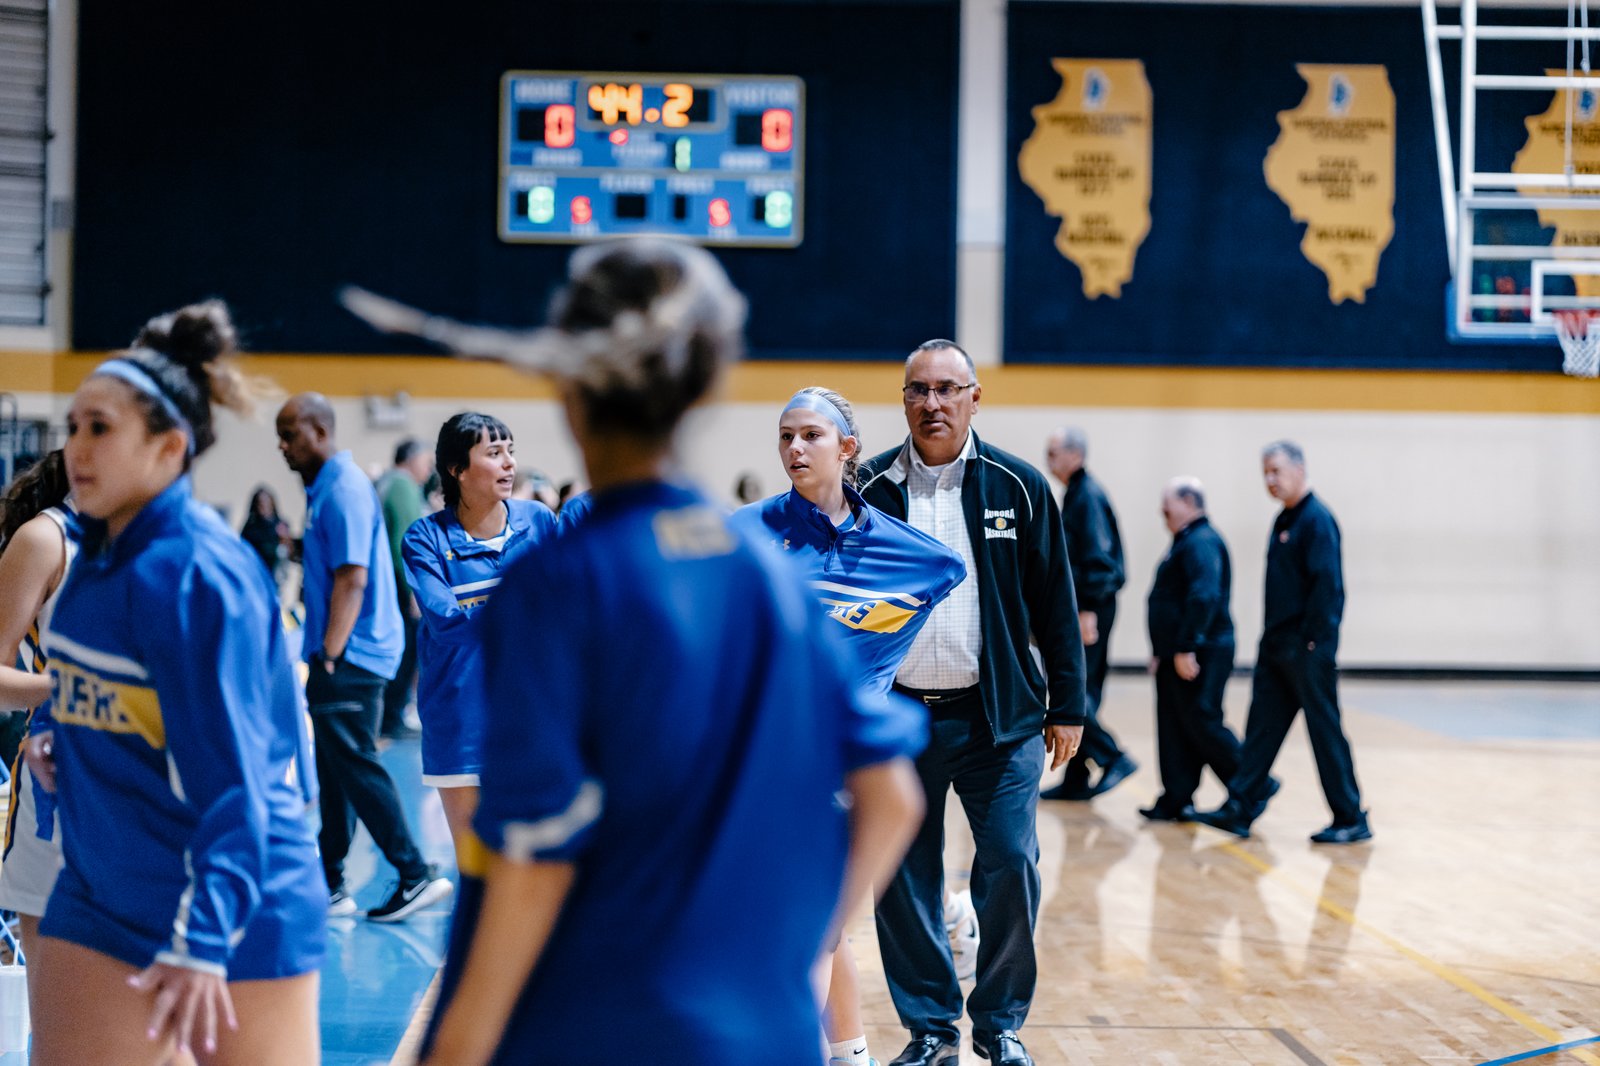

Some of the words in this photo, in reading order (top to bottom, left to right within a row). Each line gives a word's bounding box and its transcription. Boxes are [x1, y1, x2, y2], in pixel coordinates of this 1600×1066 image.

[544, 103, 576, 149] 0
[588, 82, 694, 128] 44.2
[761, 108, 793, 152] 0
[984, 508, 1015, 519] AURORA
[984, 526, 1017, 540] BASKETBALL
